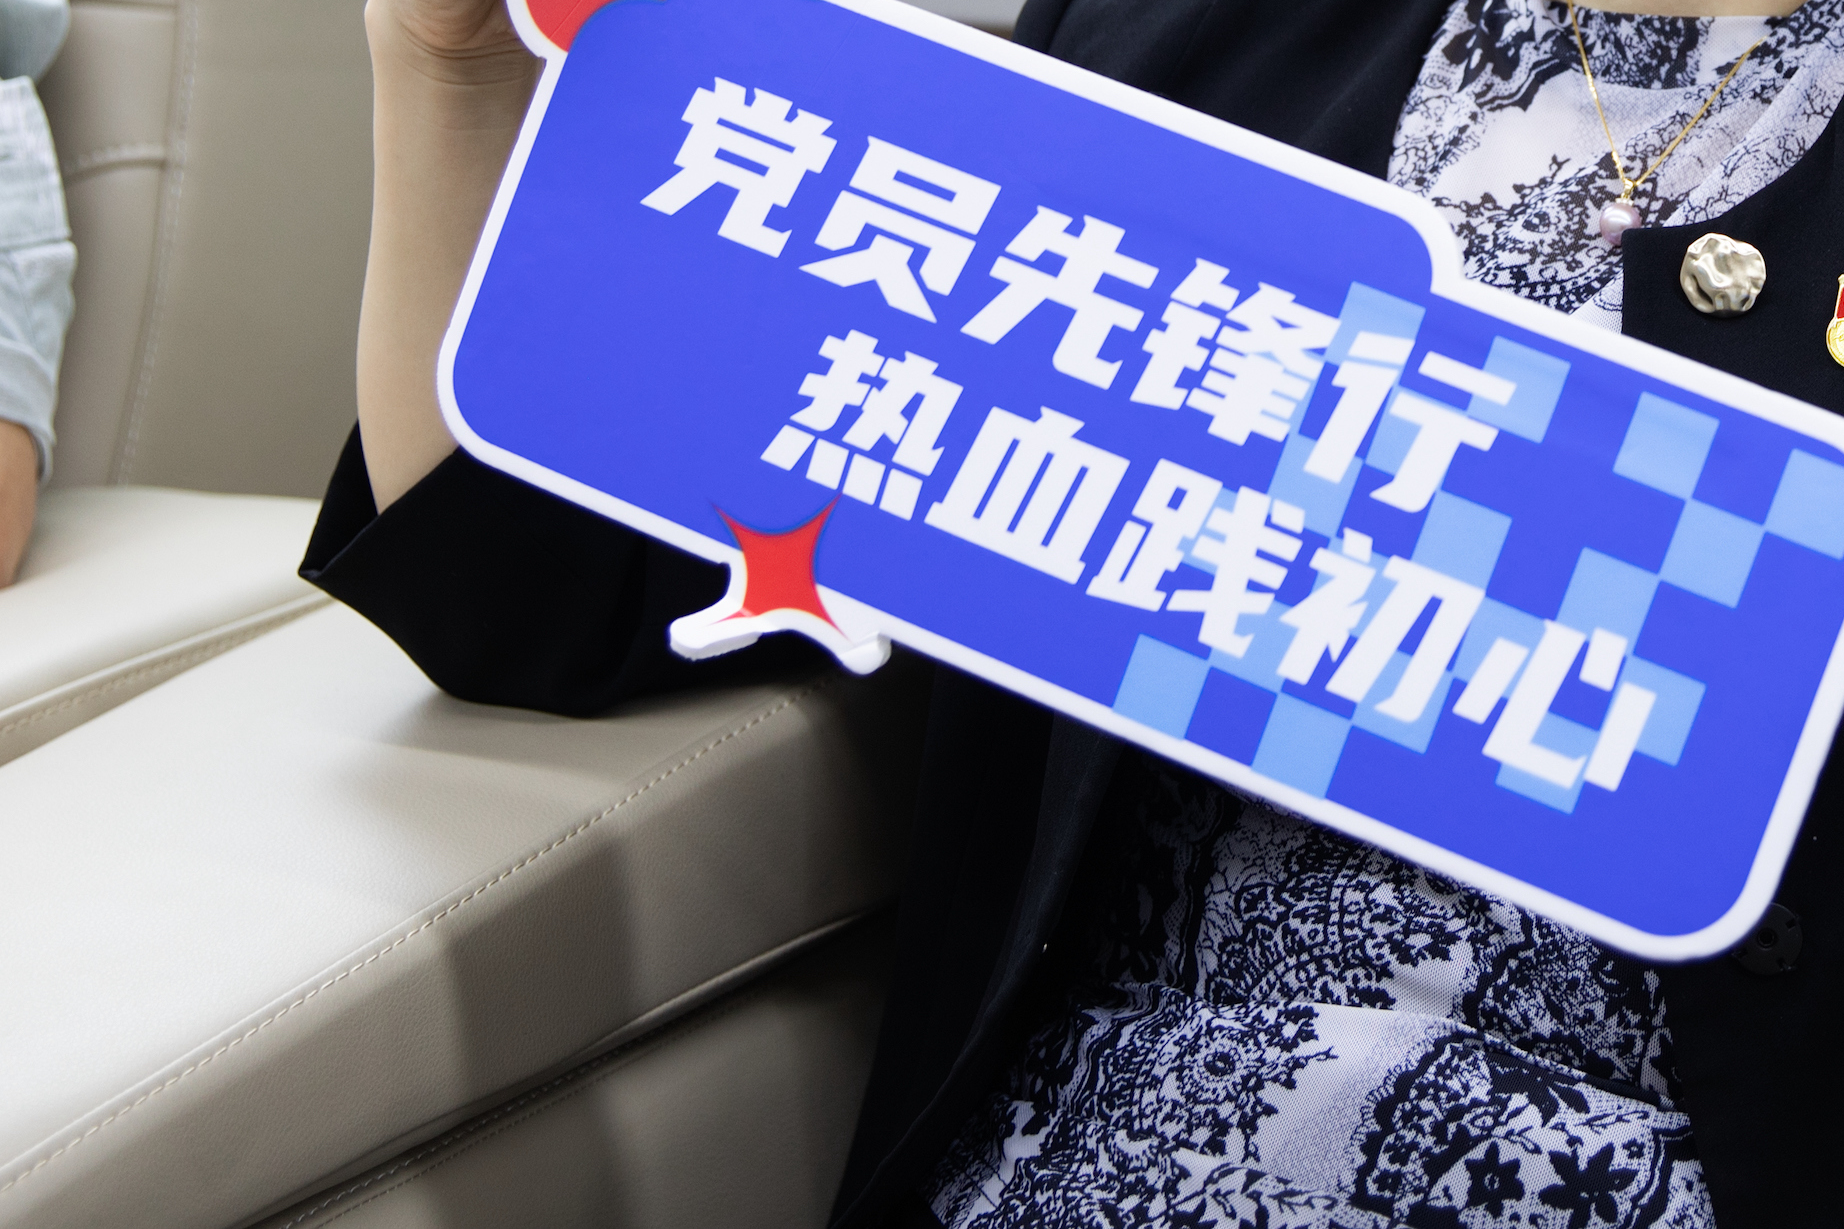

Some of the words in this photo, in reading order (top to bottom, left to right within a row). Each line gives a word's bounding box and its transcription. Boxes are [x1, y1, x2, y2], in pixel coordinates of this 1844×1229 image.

[640, 77, 1518, 513] 党员先锋行
[760, 329, 1657, 791] 热血践初心
